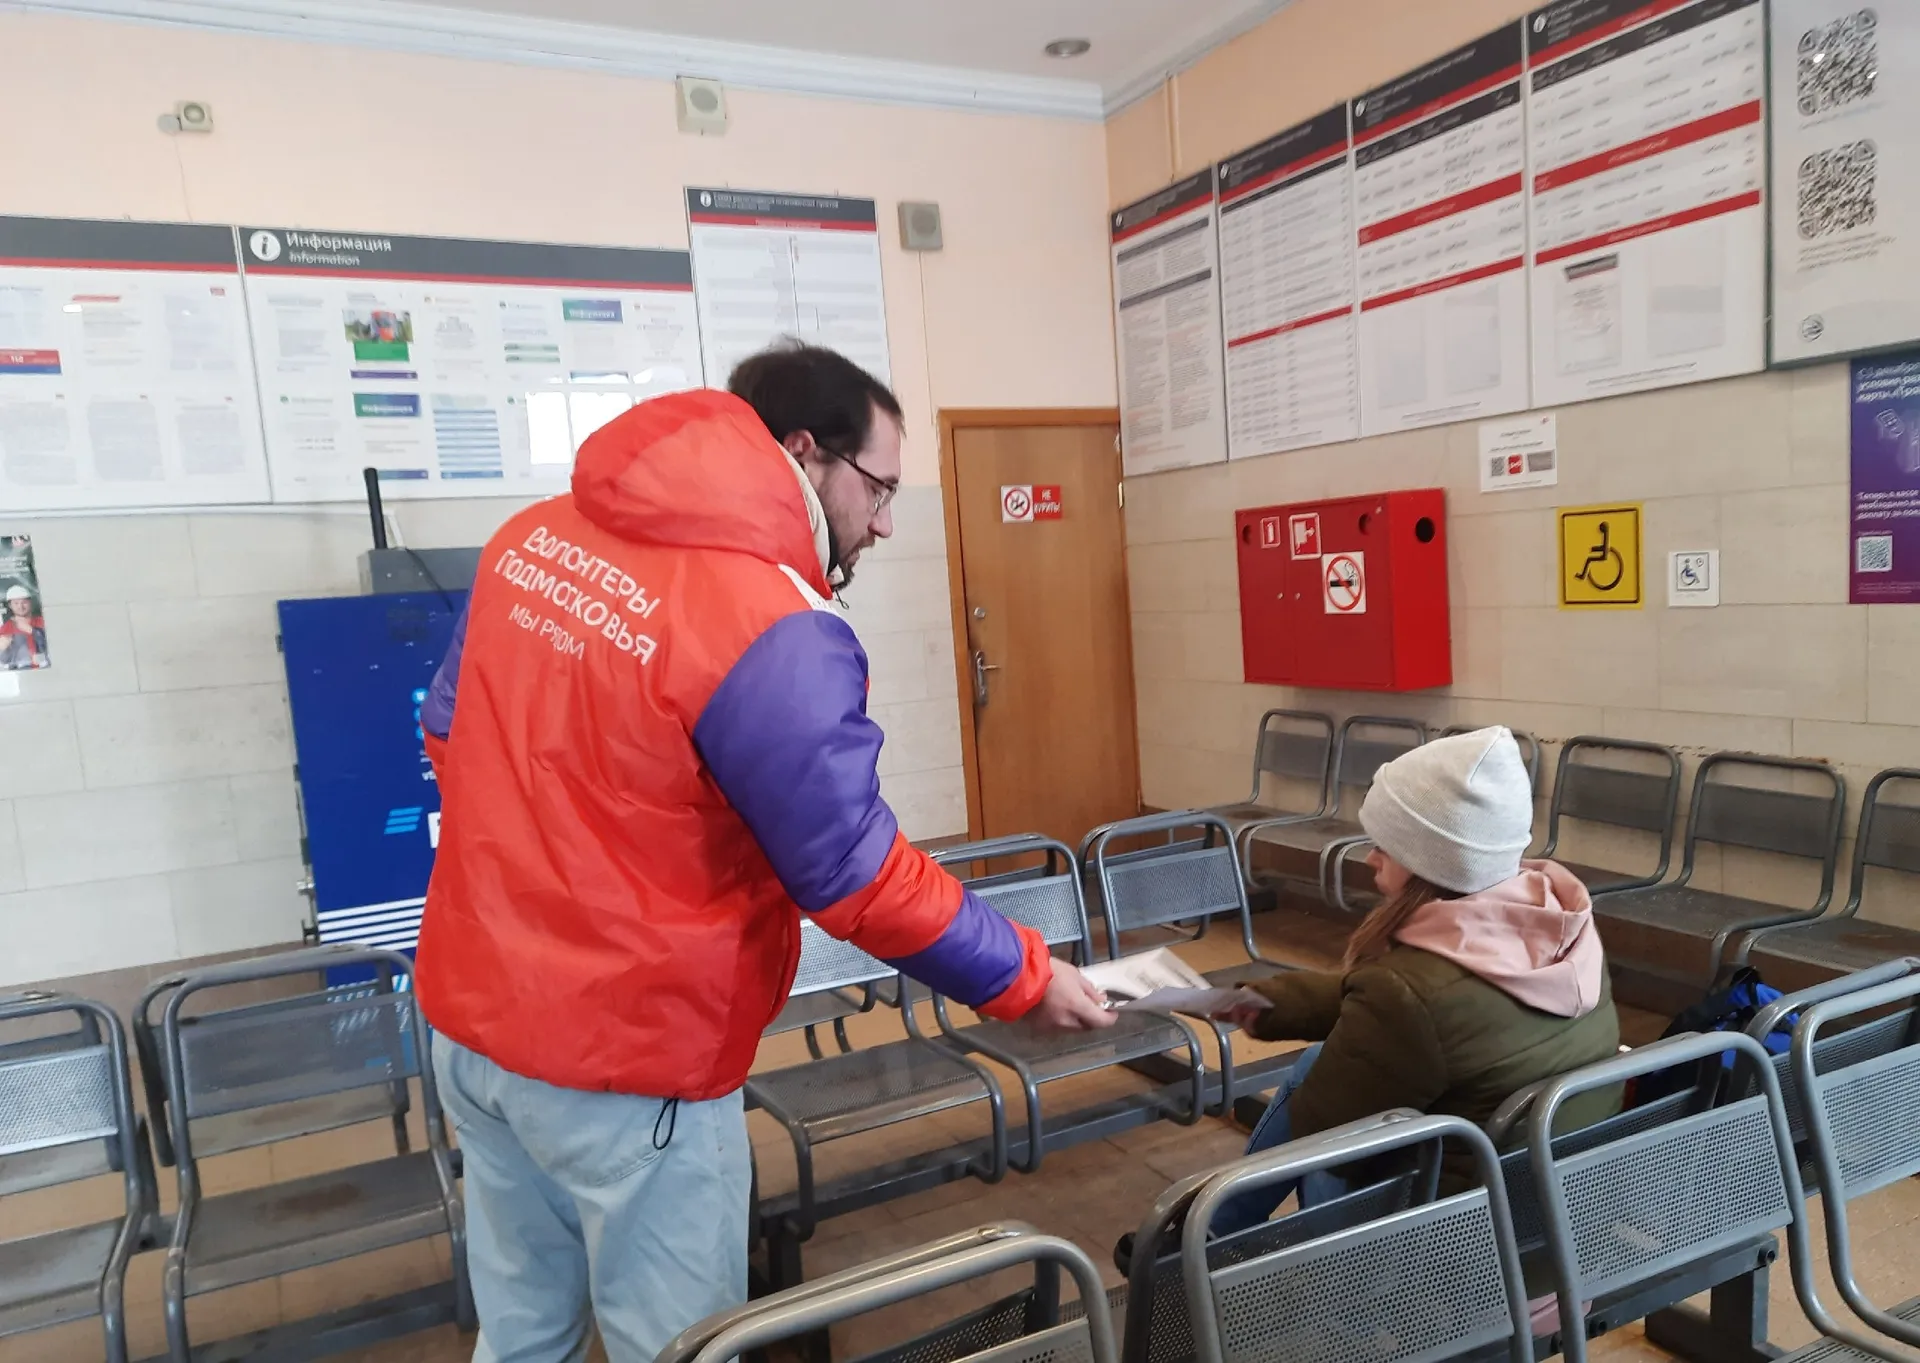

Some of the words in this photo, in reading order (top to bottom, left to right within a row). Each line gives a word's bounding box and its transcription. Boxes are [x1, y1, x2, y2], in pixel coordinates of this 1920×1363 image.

[286, 231, 392, 252] Информация
[290, 251, 361, 266] Information
[1042, 489, 1052, 500] НЕ
[522, 526, 661, 619] ВОЛОНТЕРЫ
[494, 548, 658, 666] ПОДМОСКОВЬЯ
[508, 602, 541, 632] МЫ
[539, 618, 585, 661] РЯОМ
